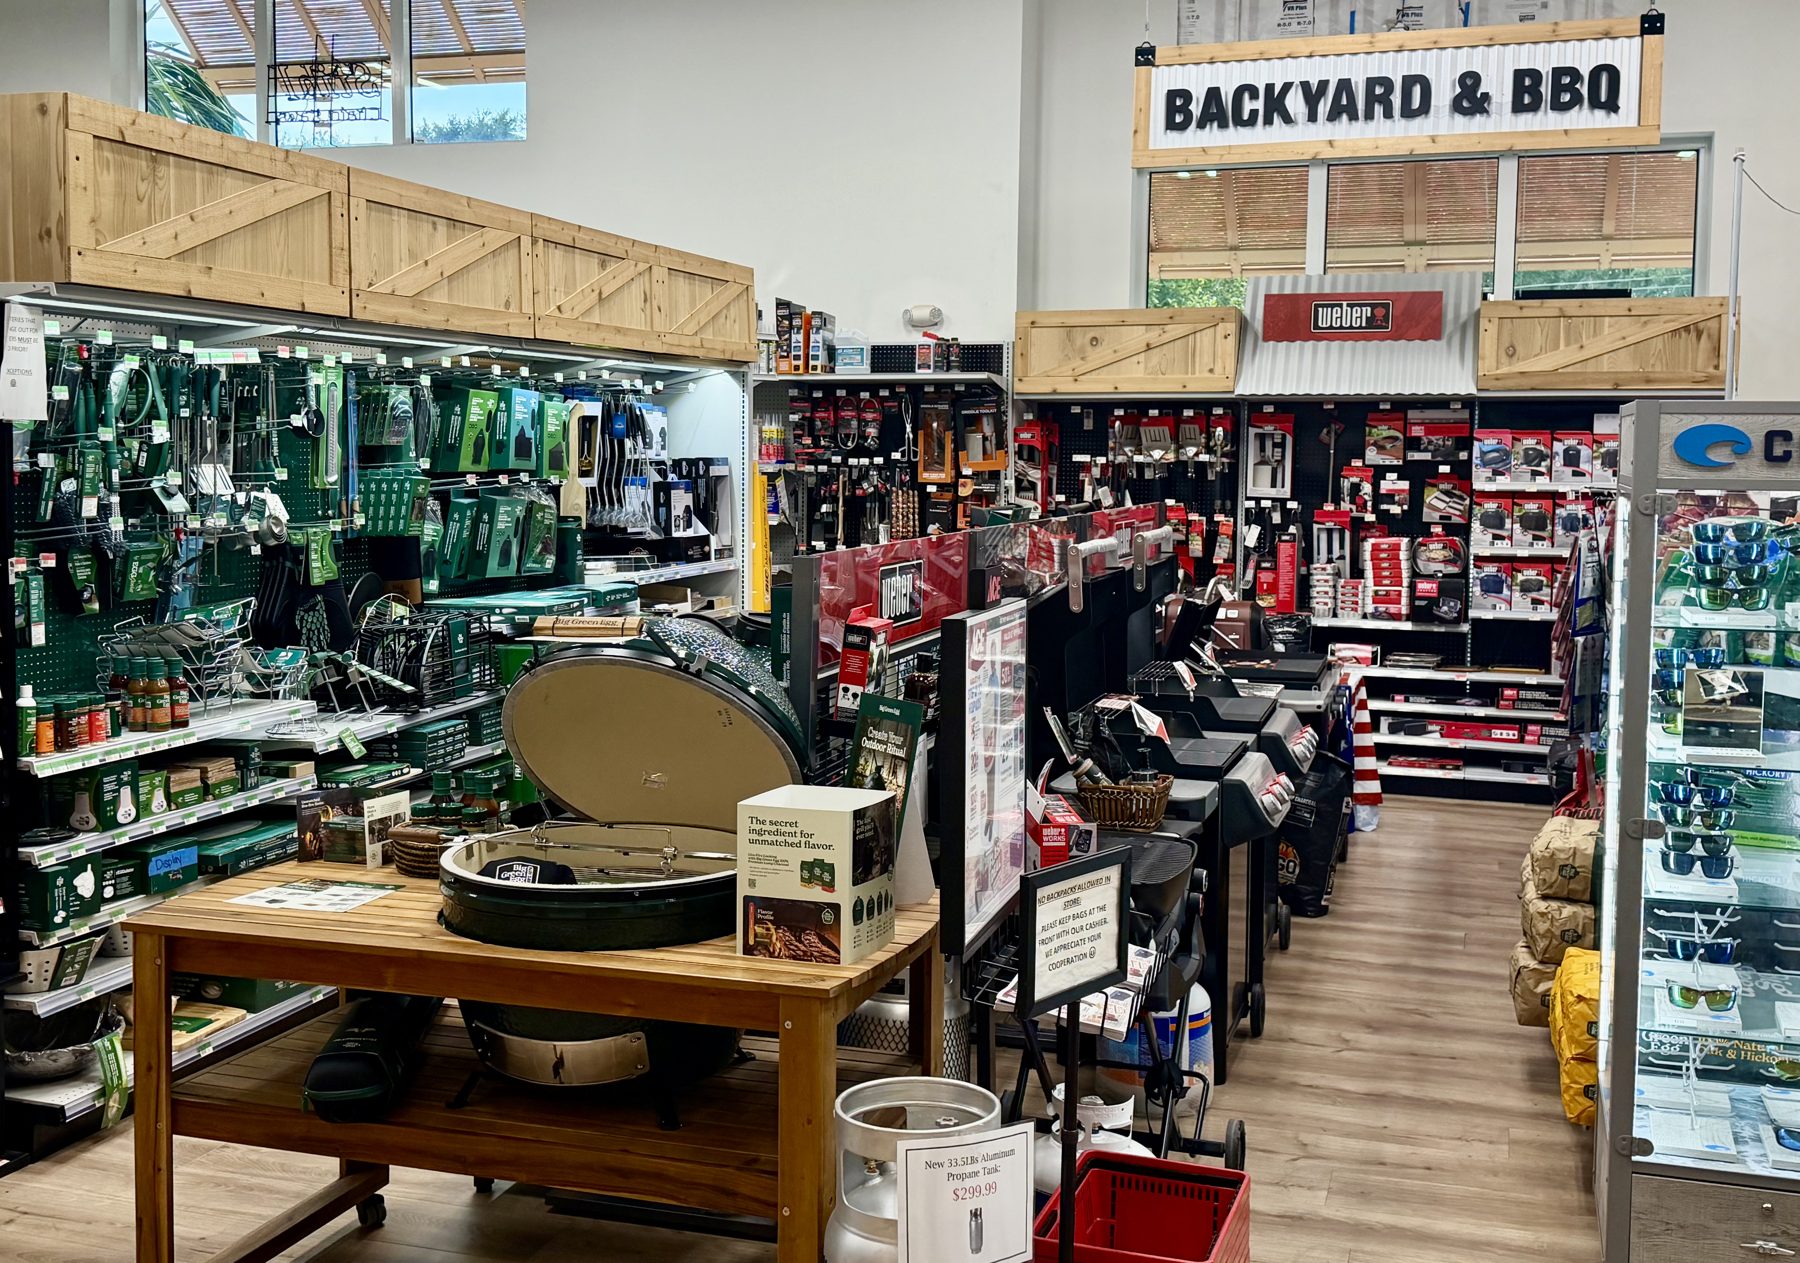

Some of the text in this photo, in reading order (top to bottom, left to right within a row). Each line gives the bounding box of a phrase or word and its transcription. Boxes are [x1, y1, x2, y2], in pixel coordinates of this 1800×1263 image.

[1165, 63, 1621, 132] BACKYARD & BBQ
[1317, 302, 1372, 328] weber
[882, 565, 913, 619] weber
[988, 575, 1001, 602] ACE
[555, 618, 570, 627] Big
[571, 618, 599, 626] Green
[868, 726, 904, 745] Create Your
[862, 736, 906, 758] Outdoor Ritual
[748, 816, 799, 828] The secret
[748, 826, 815, 839] ingredient for
[748, 838, 835, 851] unmatched flavor.
[155, 854, 182, 871] Display
[513, 864, 527, 872] Big
[501, 871, 526, 879] Green
[1037, 875, 1112, 905] NO BACKPACKS ALLOWED IN
[1041, 903, 1107, 934] PLEASE KEEP BAGS AT THE
[1038, 933, 1055, 948] FRONT
[1056, 928, 1070, 941] WITH
[1070, 923, 1085, 935] OUR
[1045, 931, 1102, 959] WE APPRECIATE YOUR
[1048, 951, 1088, 972] COOPERATION
[1650, 1042, 1681, 1056] Egg
[1726, 1048, 1737, 1059] &
[924, 1147, 1016, 1170] New 33.5LBs Aluminum
[946, 1164, 1001, 1182] Propane Tank:
[952, 1180, 997, 1202] $299.99
